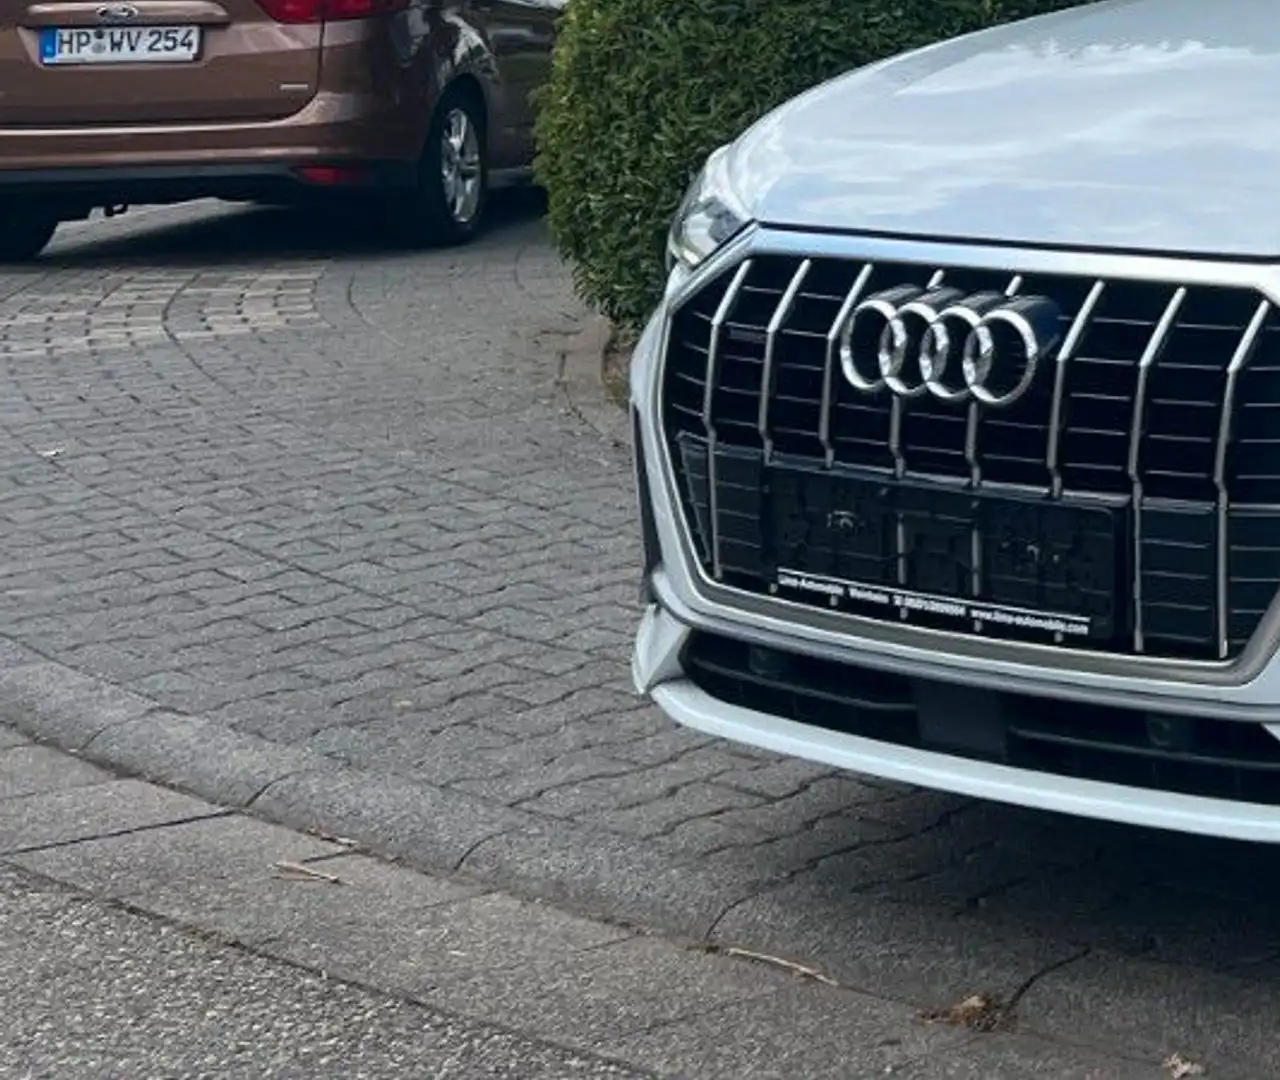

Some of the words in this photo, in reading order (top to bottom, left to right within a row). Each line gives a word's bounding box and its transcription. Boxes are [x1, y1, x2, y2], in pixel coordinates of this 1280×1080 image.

[58, 30, 91, 54] HP
[110, 30, 142, 53] WV
[148, 29, 194, 52] 254
